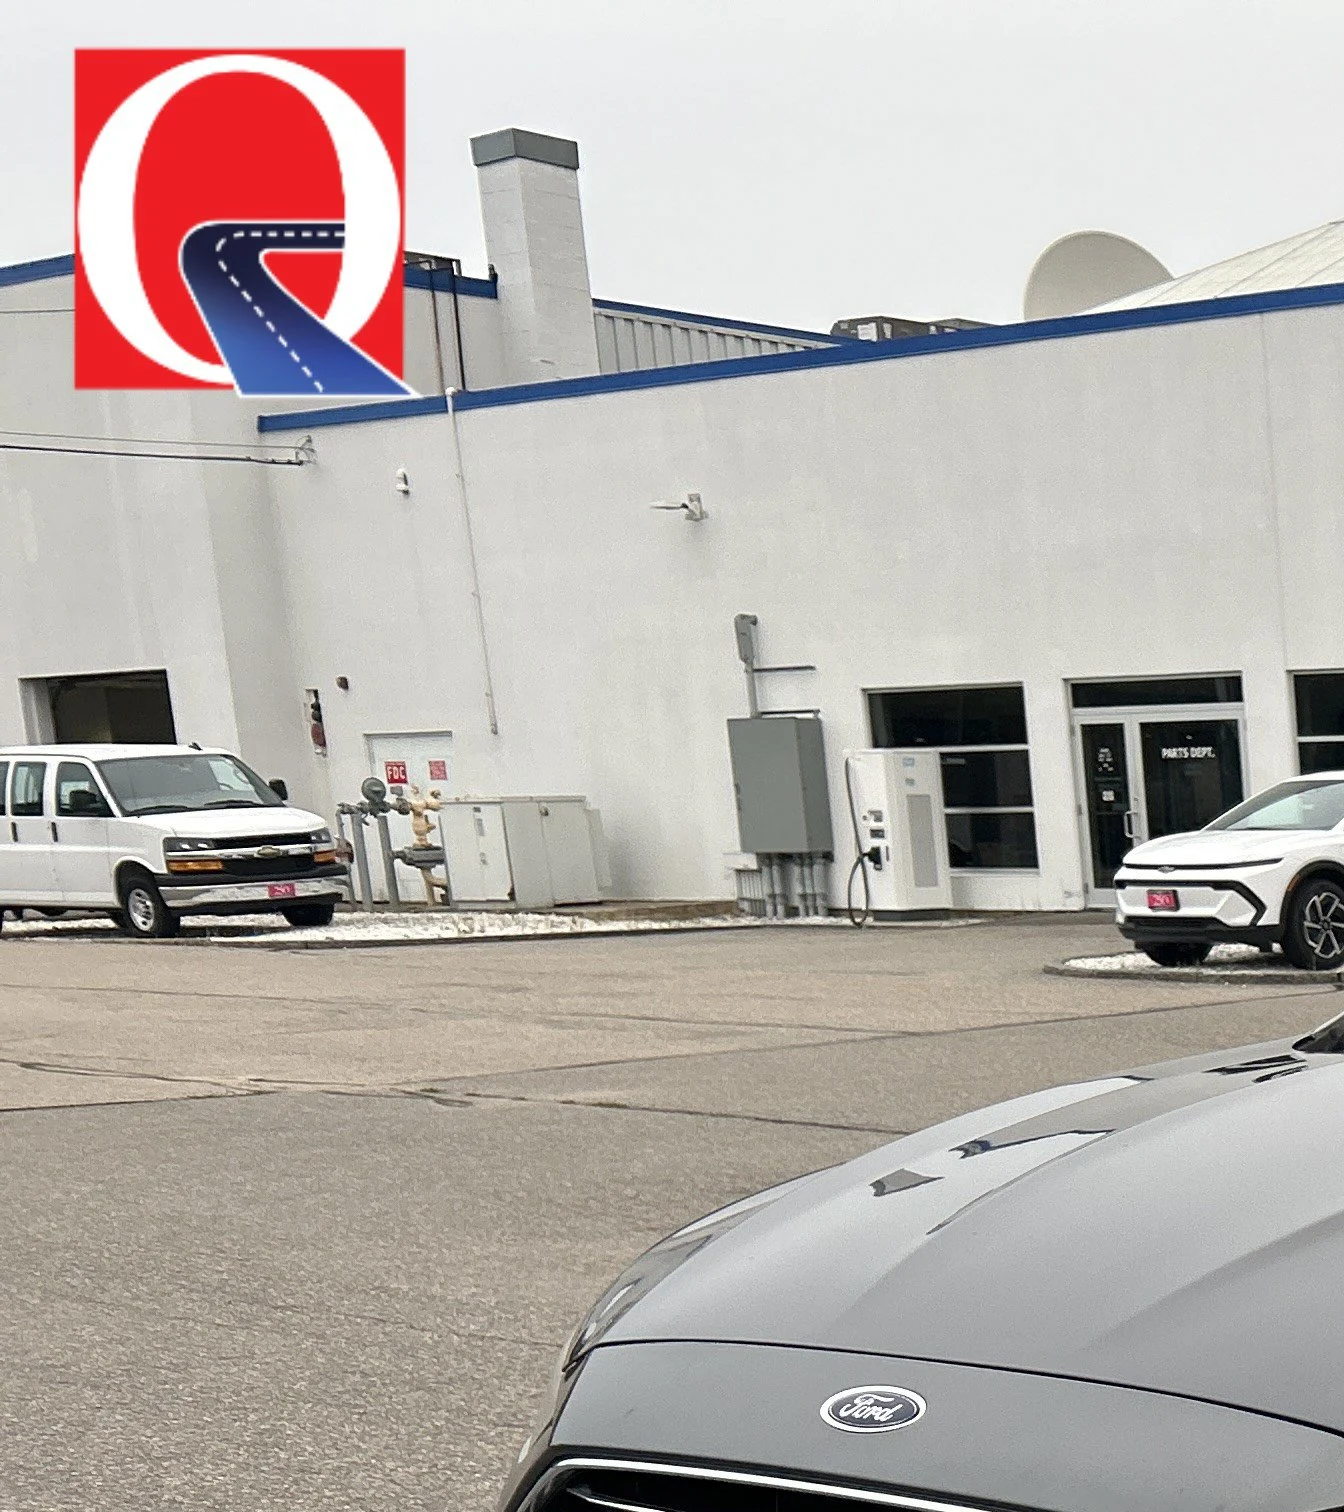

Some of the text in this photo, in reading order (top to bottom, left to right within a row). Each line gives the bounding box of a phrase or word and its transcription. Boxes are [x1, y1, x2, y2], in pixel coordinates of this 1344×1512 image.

[1161, 746, 1216, 759] PARTS DEPT.
[386, 766, 406, 780] FDC
[838, 1393, 903, 1422] Ford
